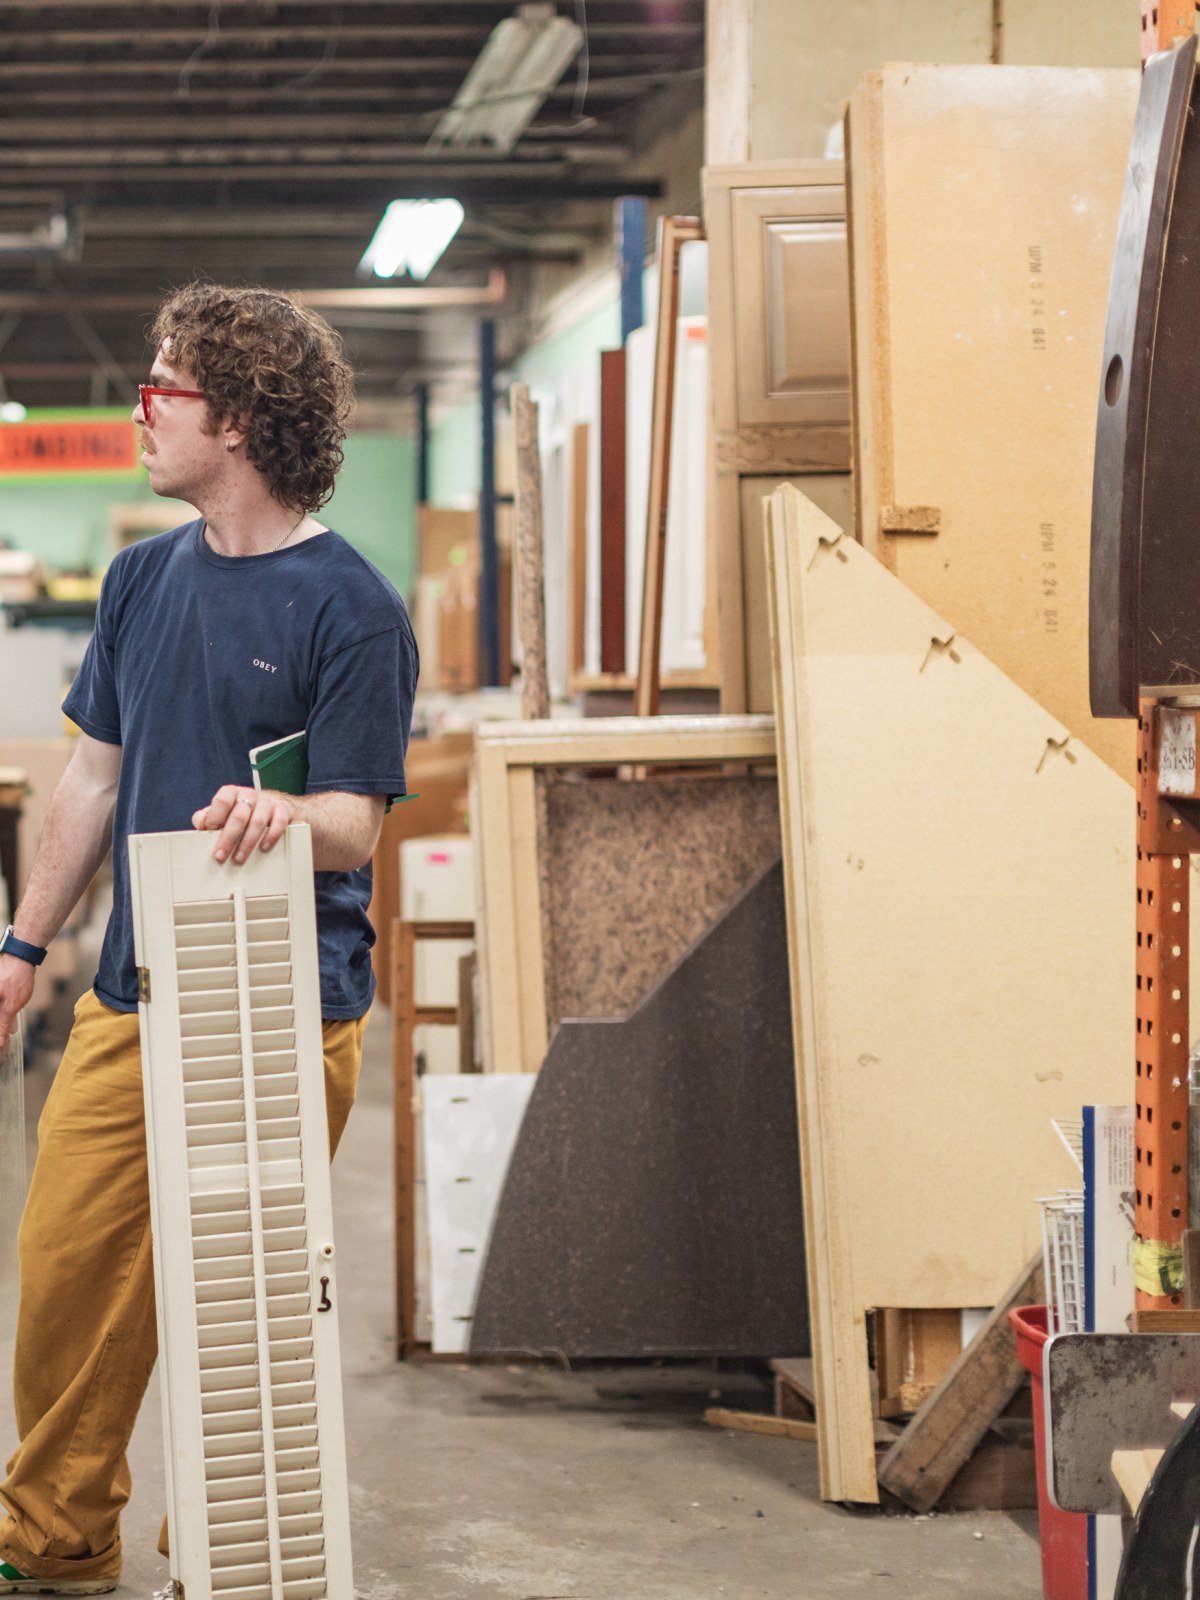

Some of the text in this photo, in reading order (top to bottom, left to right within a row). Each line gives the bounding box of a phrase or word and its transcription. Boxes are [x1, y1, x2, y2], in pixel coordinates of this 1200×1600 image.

[1028, 245, 1043, 273] UPM
[1039, 522, 1056, 552] UPM
[252, 658, 278, 673] OBEY
